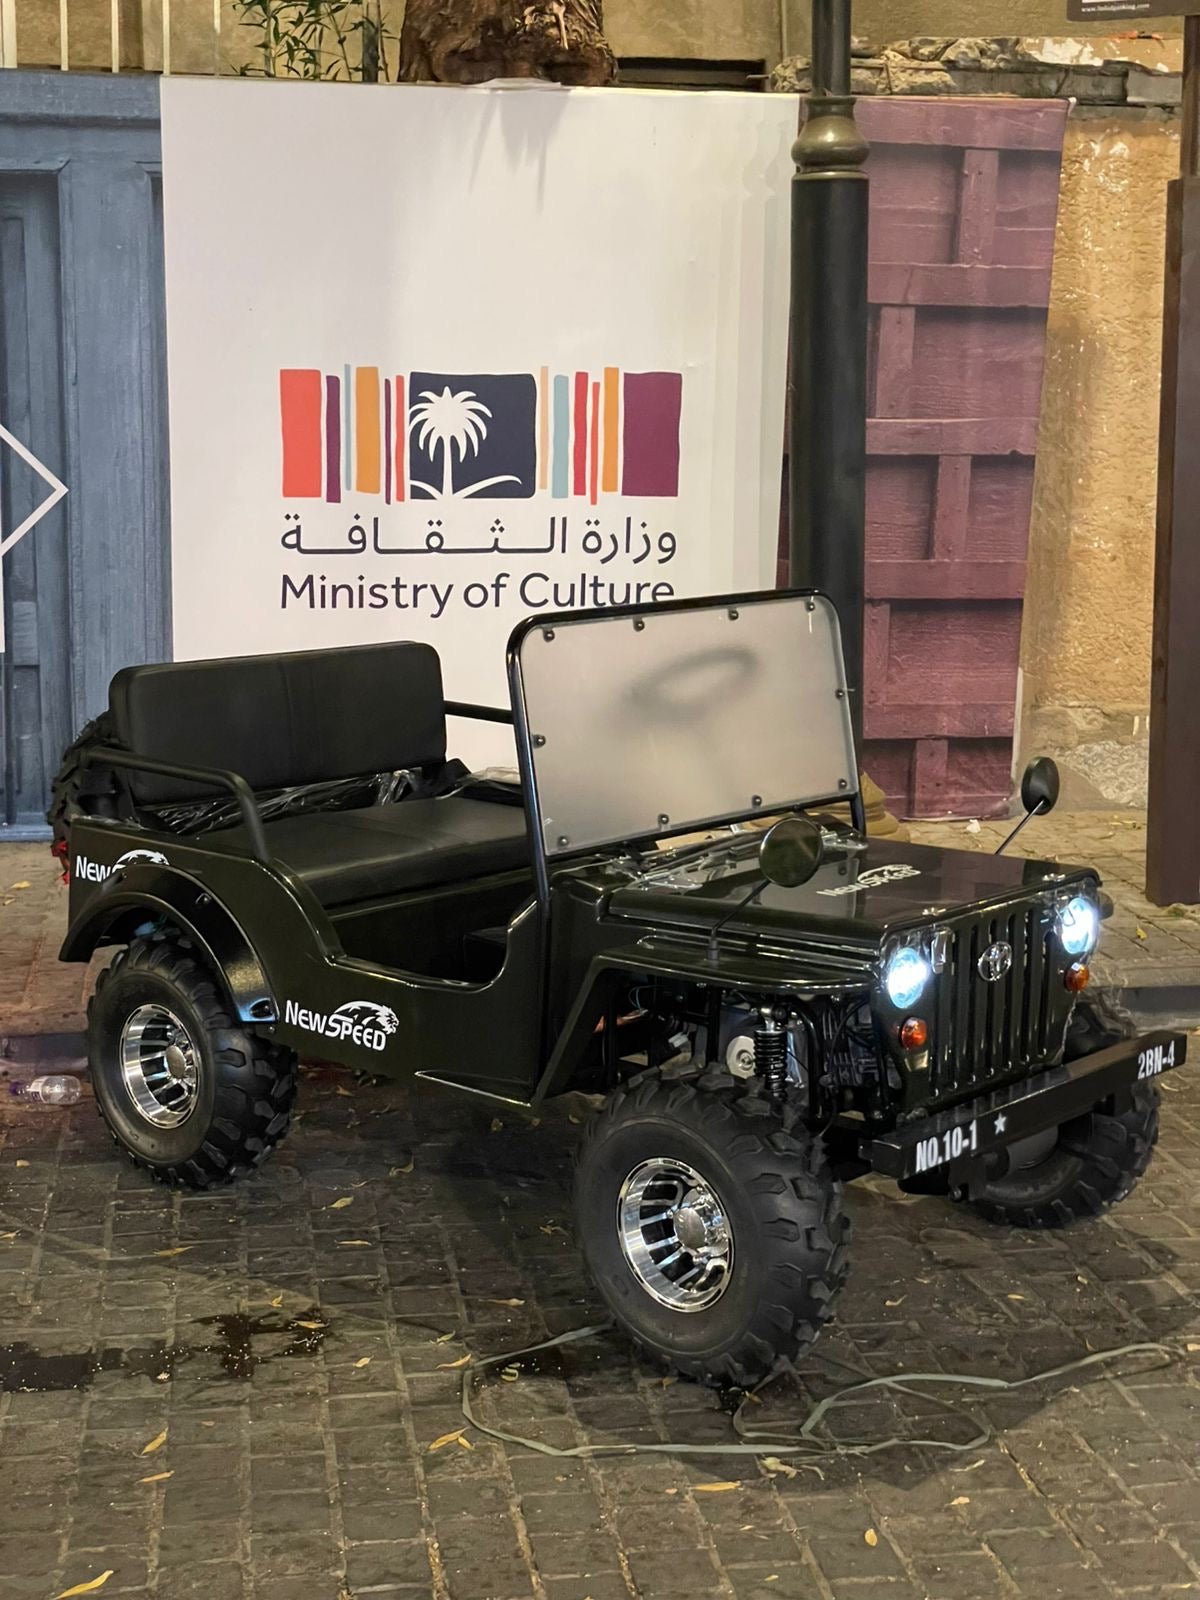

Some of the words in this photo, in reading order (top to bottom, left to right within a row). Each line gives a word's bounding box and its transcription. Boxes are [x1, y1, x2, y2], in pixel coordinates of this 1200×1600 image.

[281, 512, 567, 555] الثقافة
[582, 516, 677, 565] وزارة
[281, 573, 453, 618] Ministry
[463, 572, 510, 609] of
[519, 572, 675, 609] Culture
[1137, 1040, 1176, 1081] 2BN-4
